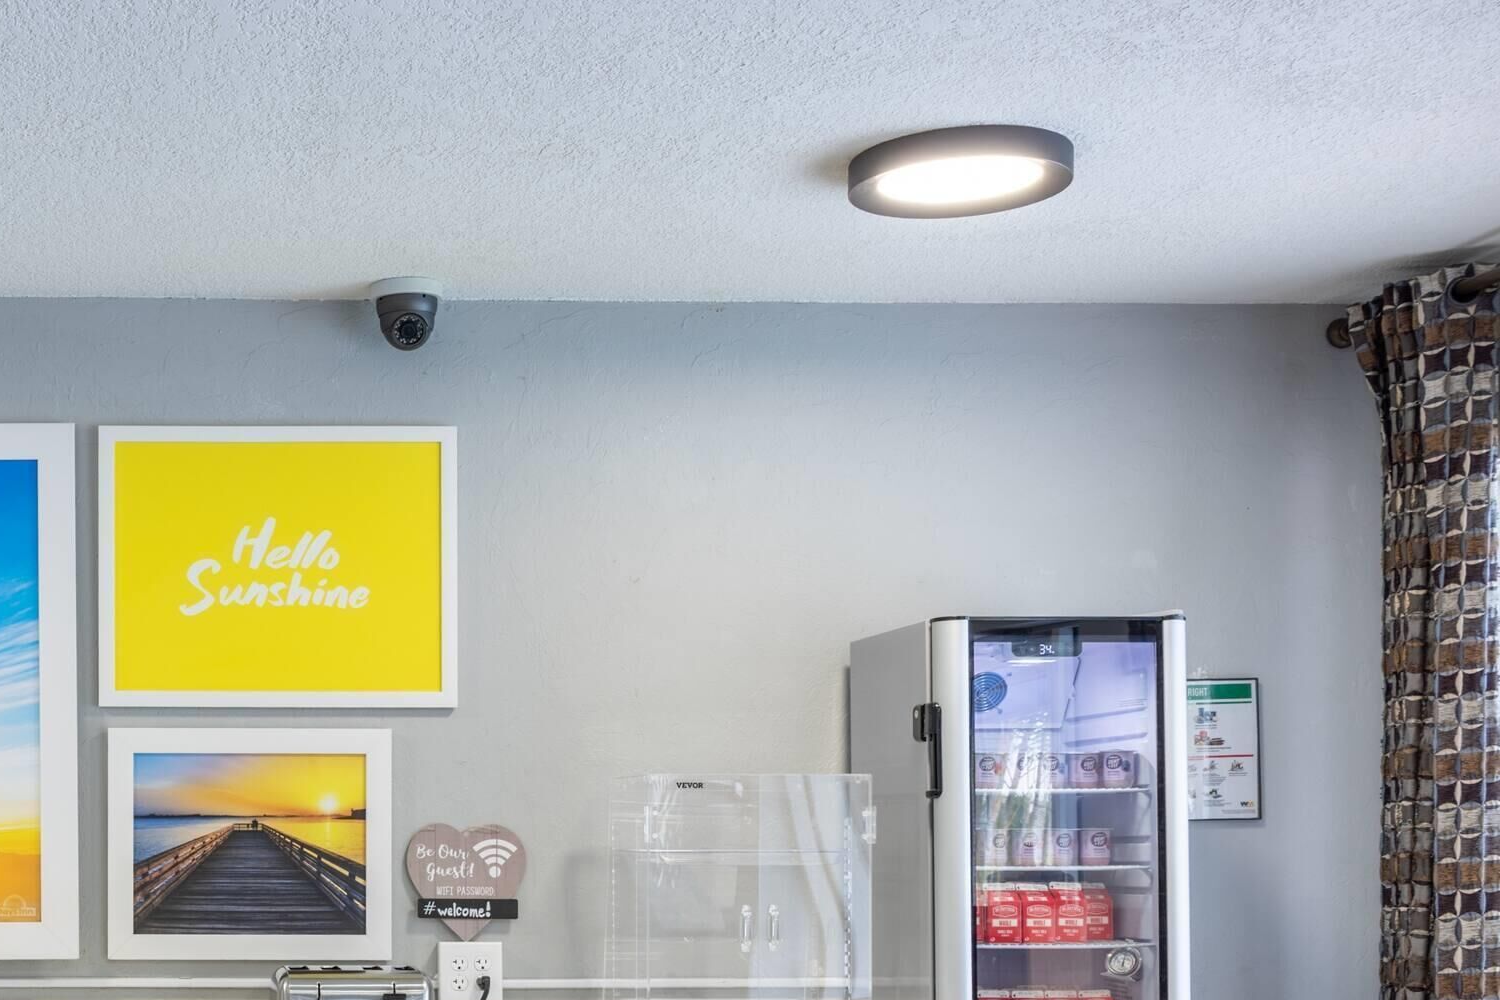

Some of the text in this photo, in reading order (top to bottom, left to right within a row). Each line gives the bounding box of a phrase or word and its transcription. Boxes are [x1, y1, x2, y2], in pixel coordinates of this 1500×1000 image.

[232, 516, 340, 570] Hello
[179, 558, 370, 616] Sunshine
[416, 843, 469, 859] Be Our
[436, 886, 454, 896] WIFI
[423, 901, 491, 918] #welcome!
